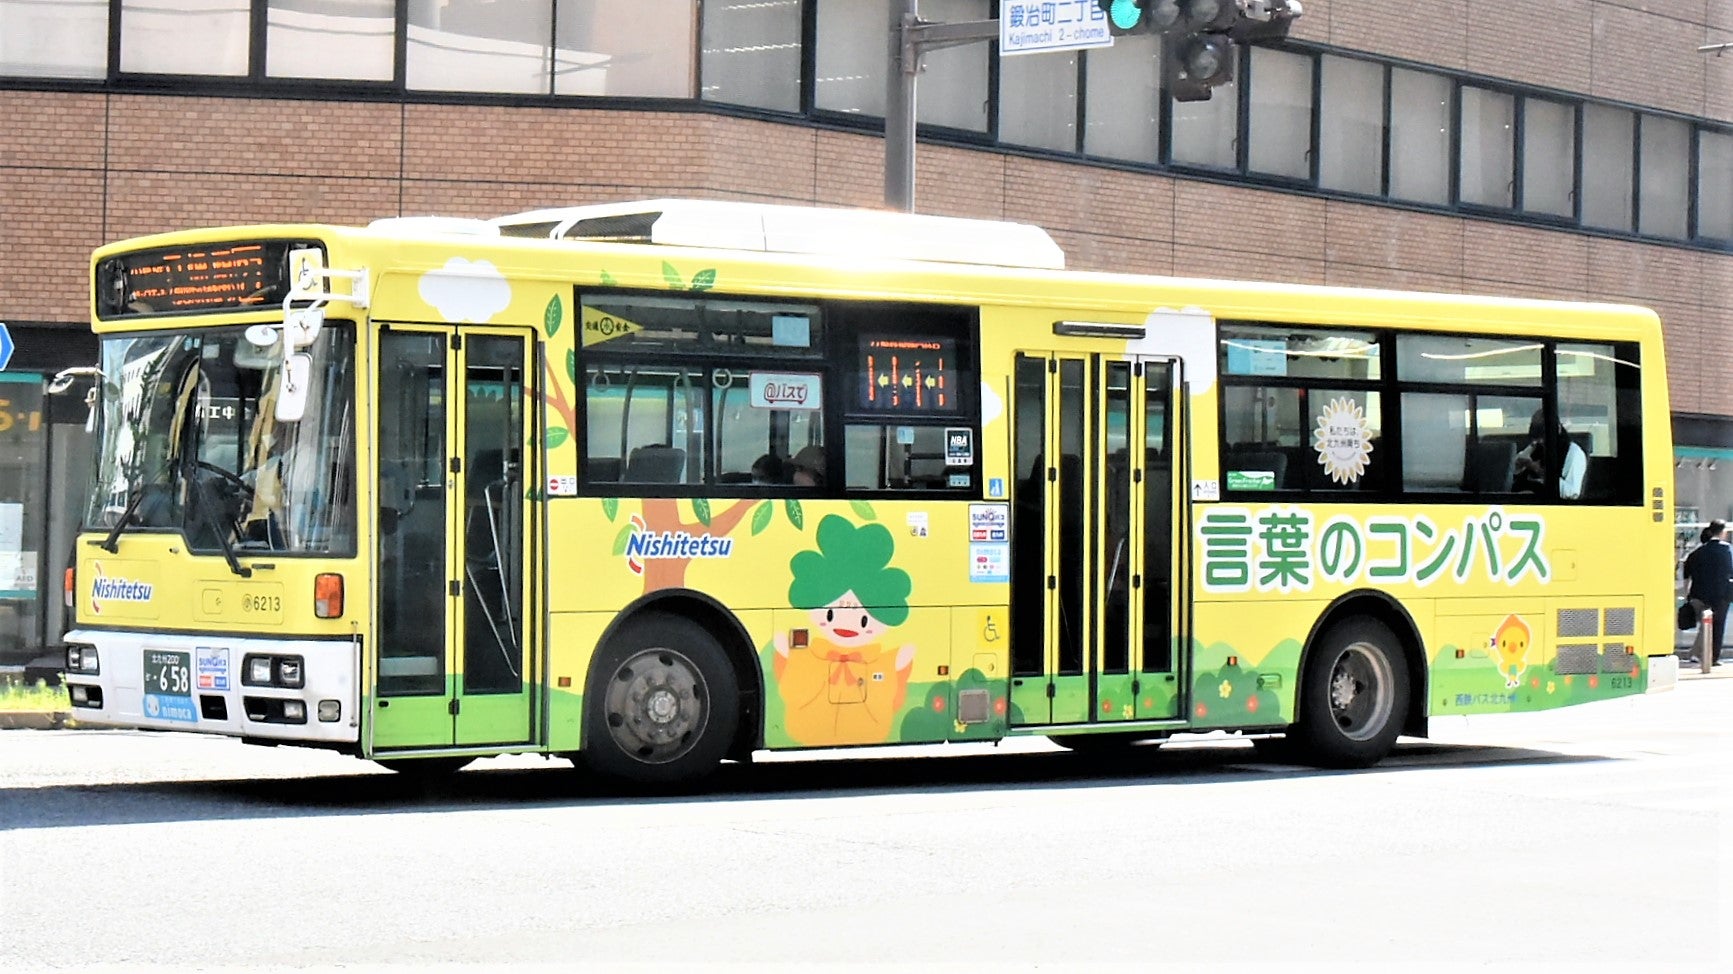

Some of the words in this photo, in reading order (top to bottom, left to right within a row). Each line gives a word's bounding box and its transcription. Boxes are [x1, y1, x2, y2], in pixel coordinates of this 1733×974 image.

[1008, 31, 1053, 46] Kajimachi
[625, 532, 732, 556] Nishitetsu
[1201, 511, 1549, 588] 言葉のコンパス
[91, 577, 153, 601] Nishitetsu
[253, 596, 281, 612] 6213
[1611, 677, 1633, 688] 6213
